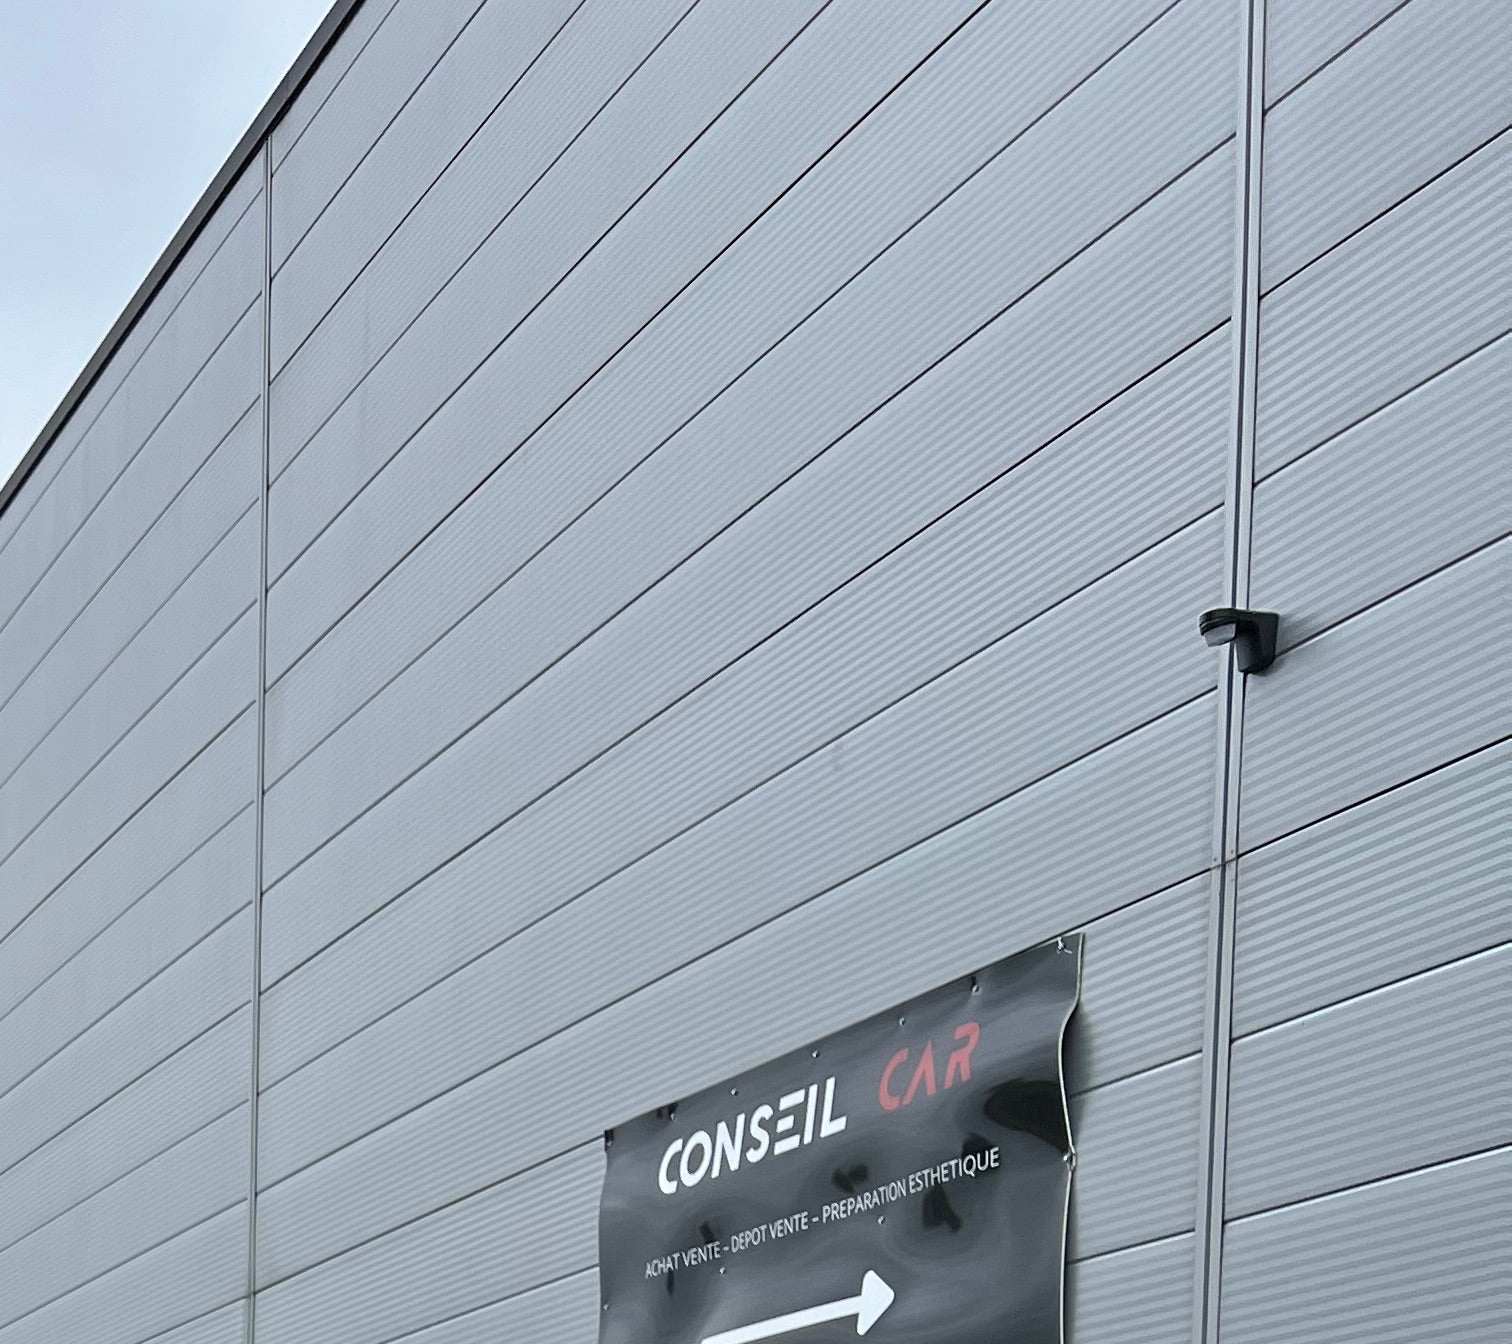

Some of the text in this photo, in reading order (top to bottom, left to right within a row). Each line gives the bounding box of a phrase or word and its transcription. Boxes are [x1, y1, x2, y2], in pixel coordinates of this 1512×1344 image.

[657, 1021, 981, 1196] CONSEIL CAR
[644, 1252, 680, 1280] ACHAT
[681, 1240, 722, 1268] VENTE
[730, 1224, 768, 1254] DEPOT
[768, 1210, 810, 1240] VENTE
[821, 1177, 908, 1225] PREPARATION
[908, 1145, 1001, 1195] ESTHETIQUE
